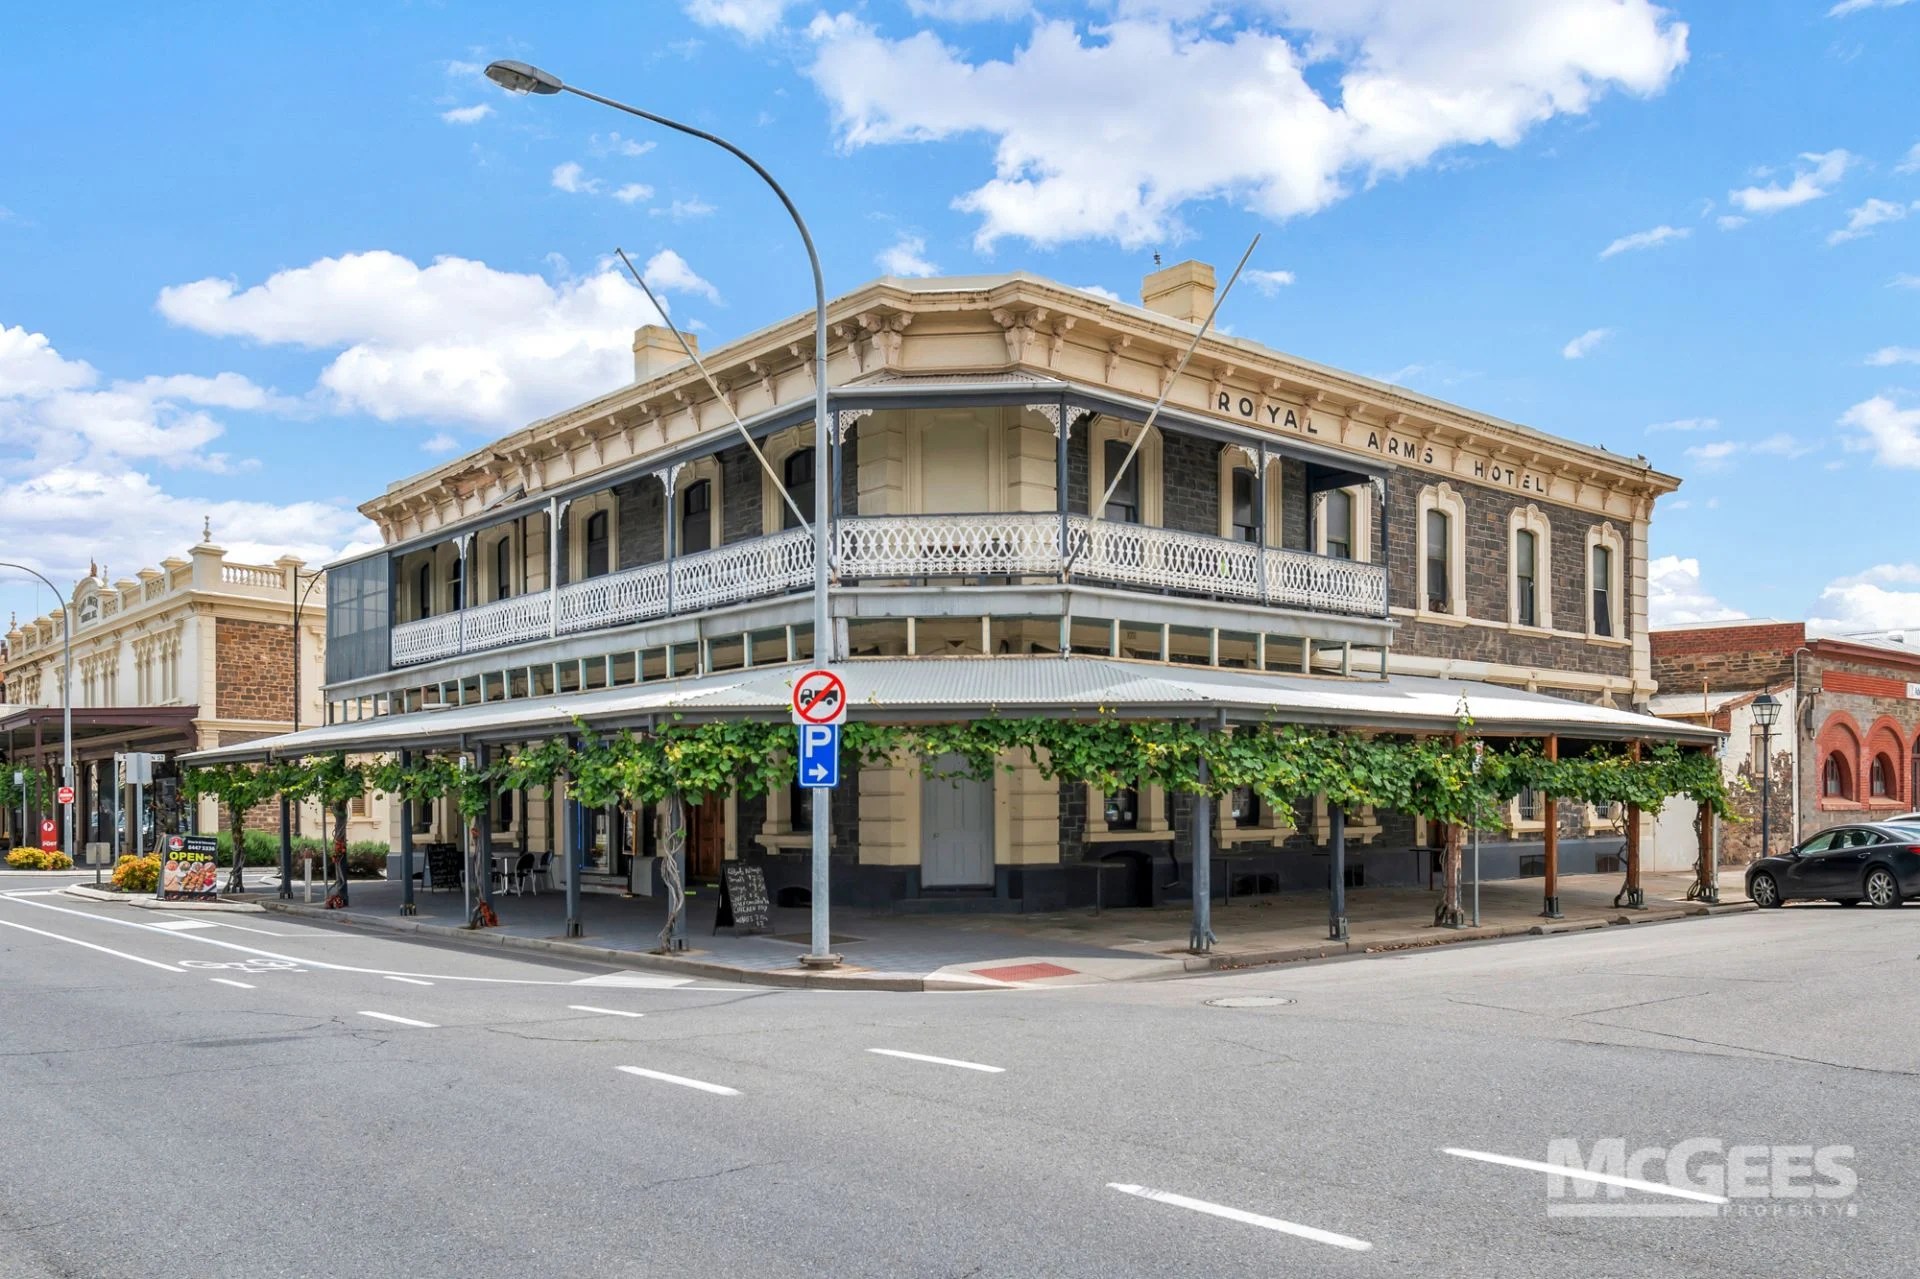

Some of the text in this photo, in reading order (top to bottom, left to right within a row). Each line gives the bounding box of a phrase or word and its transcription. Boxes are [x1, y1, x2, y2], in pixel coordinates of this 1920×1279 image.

[1218, 391, 1545, 493] ROYAL ARMS HOTEL
[805, 725, 832, 758] P
[169, 851, 204, 862] OPEN
